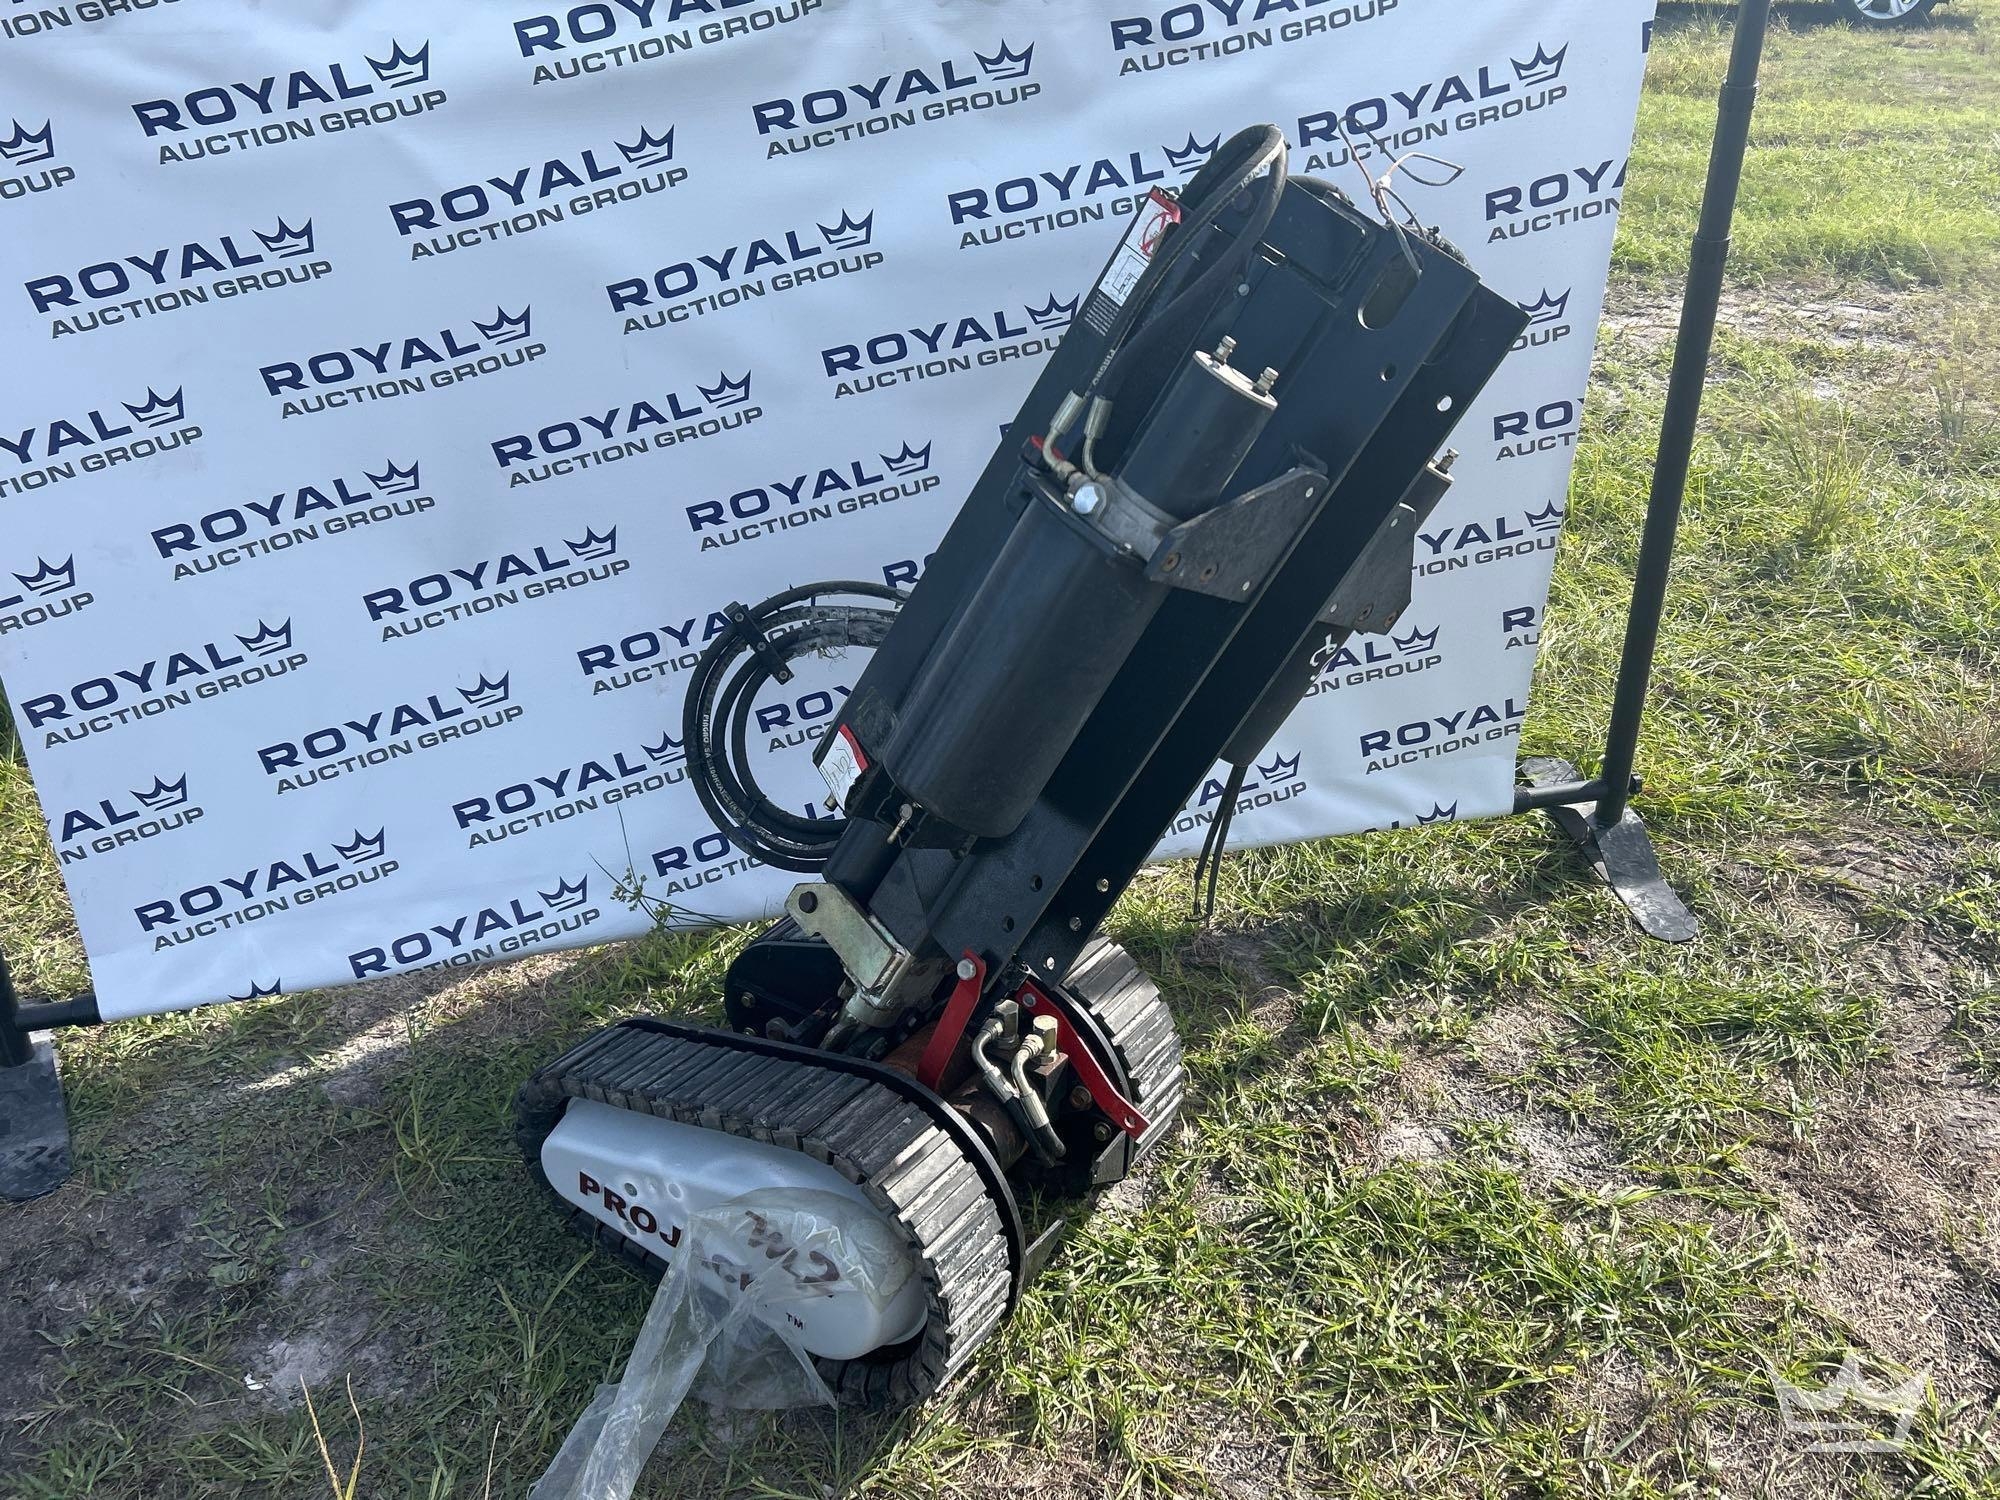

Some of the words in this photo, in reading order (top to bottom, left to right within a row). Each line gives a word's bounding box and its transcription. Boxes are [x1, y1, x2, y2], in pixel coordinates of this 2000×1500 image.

[513, 0, 750, 57] ROYA
[532, 30, 693, 86] AUCTION
[700, 0, 822, 44] GROUP
[1111, 0, 1330, 50] ROYA
[1119, 28, 1273, 76] AUCTION
[1280, 0, 1399, 42] GROUP
[131, 63, 374, 137] ROYAL
[160, 118, 315, 165] AUCTION
[320, 90, 446, 132] GROUP
[752, 60, 977, 135] ROYAL
[767, 109, 915, 160] AUCTION
[922, 82, 1041, 122] GROUP
[1298, 66, 1511, 148] ROYAL
[1304, 118, 1448, 173] AUCTION
[1455, 85, 1567, 132] GROUP
[0, 166, 76, 199] OUP
[389, 150, 622, 236] ROYAL
[412, 204, 564, 261] AUCTION
[569, 168, 688, 215] GROUP
[948, 152, 1165, 225] ROYAL
[1485, 159, 1629, 221] ROY
[960, 202, 1104, 249] AUCTION
[24, 236, 264, 313] ROYAL
[52, 286, 209, 339] AUCTION
[213, 261, 332, 298] GROUP
[606, 231, 822, 313] ROYAL
[624, 280, 765, 335] AUCTION
[771, 252, 883, 291] GROUP
[259, 329, 481, 396] ROYAL
[282, 377, 425, 419] AUCTION
[430, 343, 546, 387] GROUP
[821, 310, 1028, 378] ROYAL
[834, 355, 972, 399] AUCTION
[977, 334, 1064, 366] GROU
[0, 410, 133, 464] YAL
[80, 426, 203, 472] GROUP
[491, 393, 703, 467] ROYAL
[510, 438, 649, 488] AUCTION
[654, 407, 762, 448] GROUP
[1495, 431, 1576, 461] AUCT
[151, 478, 372, 558] ROYAL
[686, 461, 884, 532] ROYAL
[701, 504, 832, 552] AUCTION
[837, 476, 940, 514] GROUP
[174, 525, 319, 581] AUCTION
[324, 497, 435, 534] GROUP
[1417, 516, 1524, 555] YAL
[1474, 536, 1556, 564] GROU
[0, 592, 94, 635] ROUP
[363, 547, 570, 621] ROYAL
[382, 590, 519, 642] AUCTION
[523, 560, 630, 599] GROUP
[20, 643, 244, 728] ROYAL
[46, 690, 191, 749] AUCTION
[196, 654, 307, 698] GROUP
[593, 652, 700, 696] AUCTIO
[1346, 654, 1442, 686] GROUP
[257, 695, 464, 775] ROYAL
[278, 740, 413, 794] AUCTION
[418, 706, 523, 748] GROUP
[1360, 698, 1525, 758] ROYAL
[1366, 733, 1480, 775] AUCTION
[452, 752, 647, 829] ROYAL
[468, 796, 598, 849] AUCTION
[91, 807, 204, 854] GROUP
[134, 852, 339, 932] ROYAL
[154, 901, 289, 952] AUCTION
[293, 860, 400, 905] GROUP
[348, 899, 544, 979] ROYAL
[500, 908, 600, 952] GROUP
[785, 1312, 806, 1331] TM
